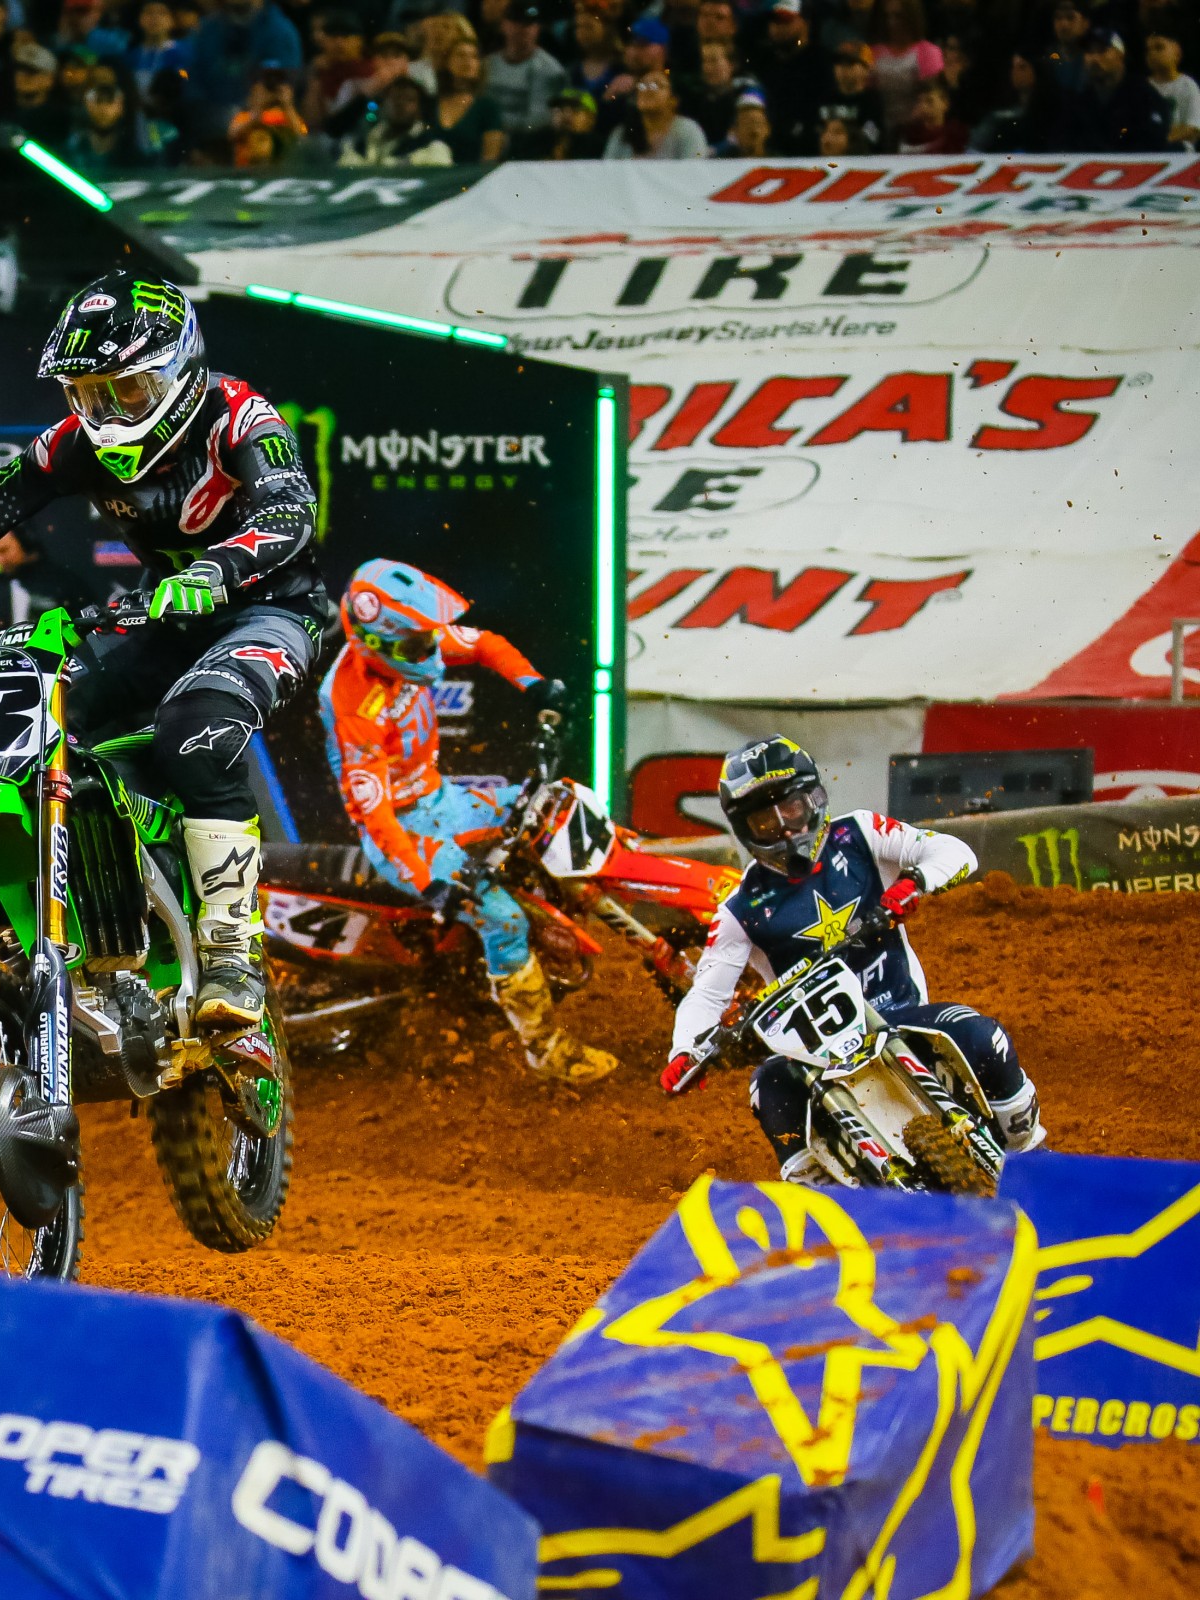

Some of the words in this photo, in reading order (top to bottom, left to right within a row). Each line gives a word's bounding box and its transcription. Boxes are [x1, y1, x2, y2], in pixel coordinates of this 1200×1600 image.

[83, 298, 109, 308] BELL
[340, 429, 551, 472] MONSTER
[372, 474, 519, 490] ENERGY
[116, 616, 147, 626] ARC
[568, 798, 615, 871] 4
[288, 899, 349, 954] 4
[39, 1012, 50, 1074] CARRILLO
[782, 979, 858, 1055] 15
[56, 994, 69, 1105] DUNLOP
[1031, 1393, 1200, 1440] PERCROS
[23, 1460, 184, 1515] TIRES
